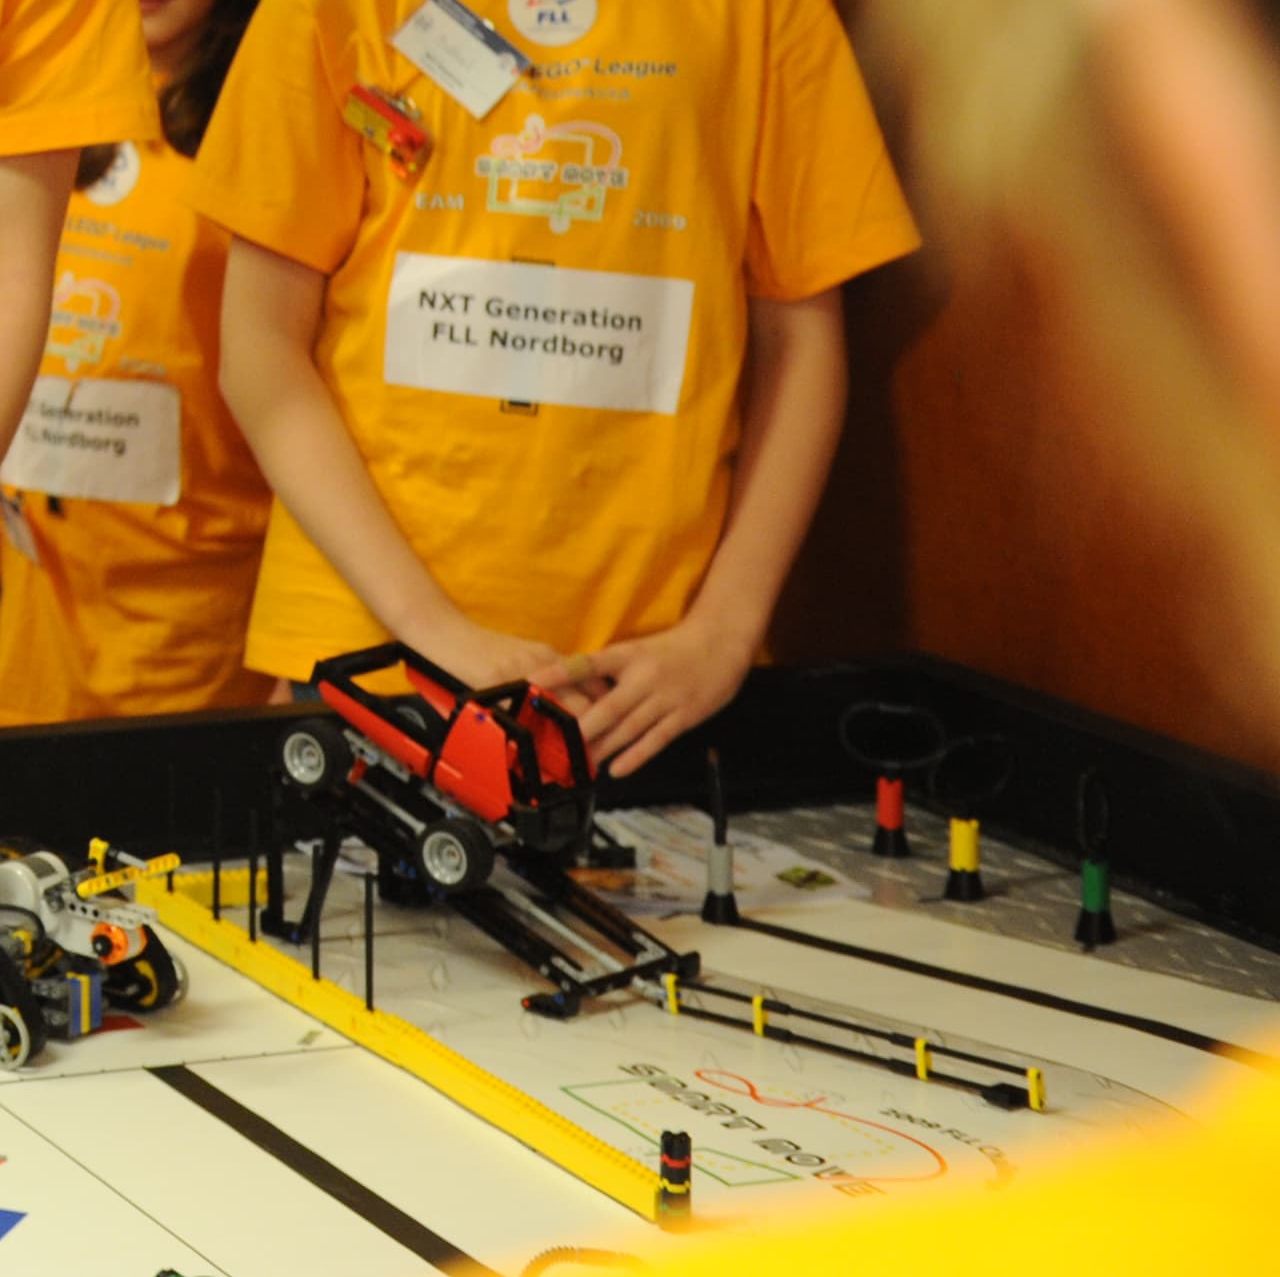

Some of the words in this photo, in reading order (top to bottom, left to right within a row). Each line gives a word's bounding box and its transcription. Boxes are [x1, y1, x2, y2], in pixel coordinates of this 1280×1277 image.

[537, 10, 569, 24] FLL
[594, 57, 678, 78] League
[418, 290, 473, 314] NXT
[485, 298, 643, 332] Generation
[432, 322, 478, 346] FLL
[489, 329, 624, 365] Nordborg
